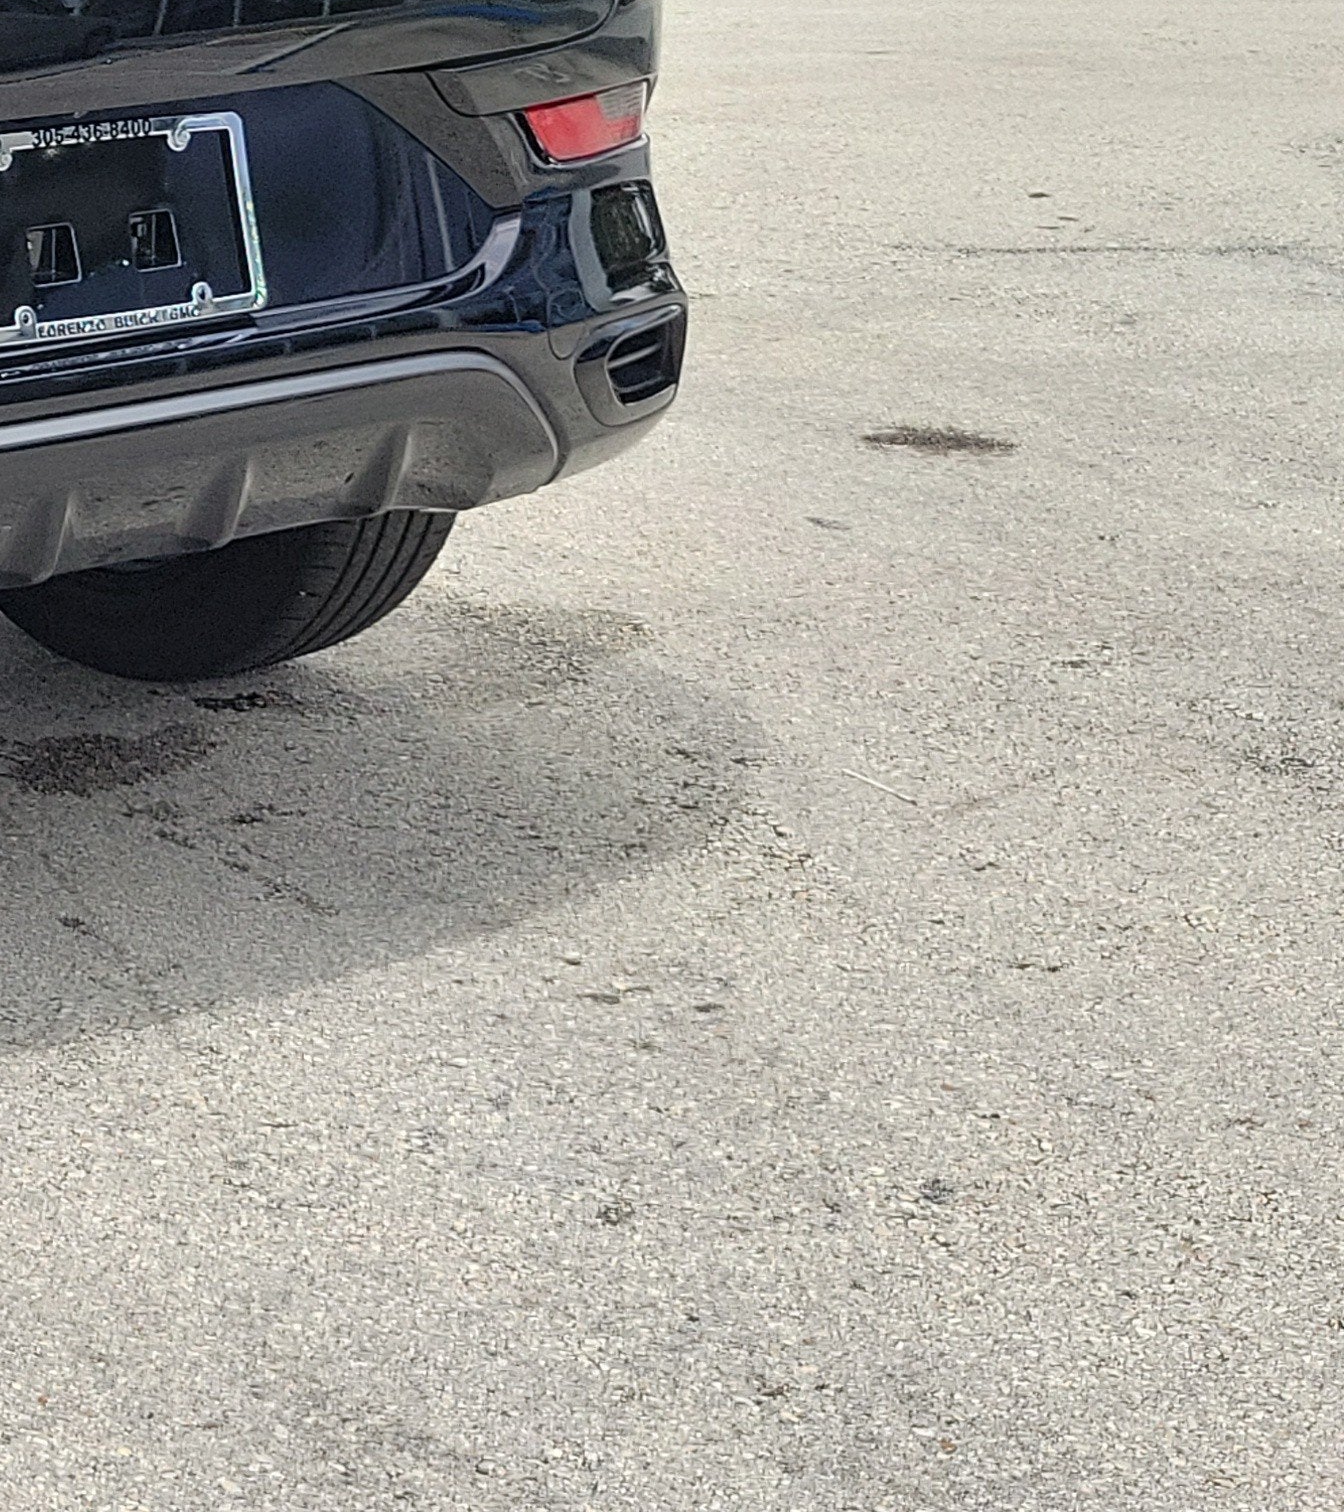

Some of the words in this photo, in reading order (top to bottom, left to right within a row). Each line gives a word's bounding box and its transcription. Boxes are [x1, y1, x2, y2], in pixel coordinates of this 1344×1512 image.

[32, 117, 151, 147] 305-436-8400
[38, 318, 106, 338] LORENZO
[114, 313, 160, 328] BUICK
[169, 304, 202, 320] GMC
